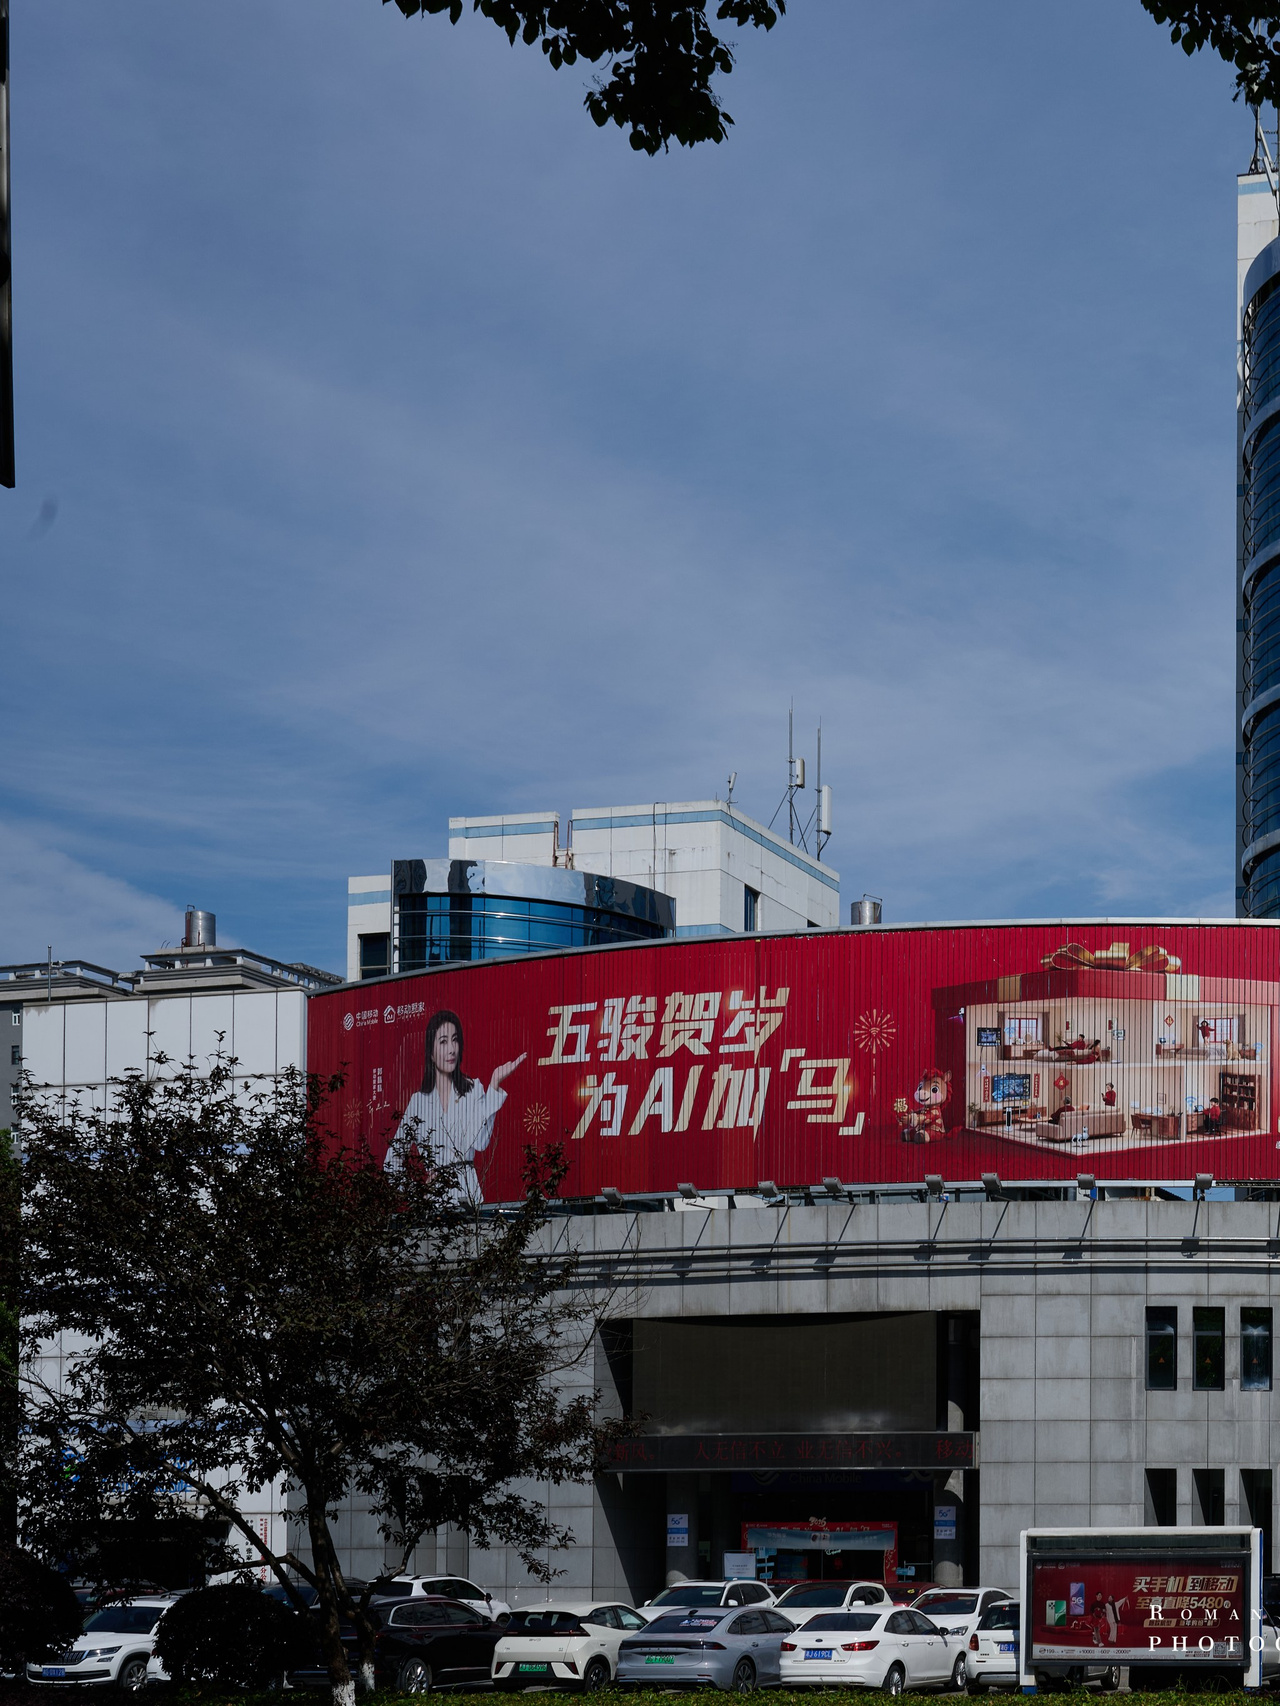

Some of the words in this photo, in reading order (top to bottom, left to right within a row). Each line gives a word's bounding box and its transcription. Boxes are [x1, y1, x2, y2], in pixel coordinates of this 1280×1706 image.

[538, 986, 790, 1066] 五骏贺岁
[694, 1440, 785, 1461] 人无信不立
[935, 1439, 971, 1461] 移动
[823, 1471, 863, 1484] Mobile
[1133, 1576, 1185, 1592] 买手机
[1188, 1576, 1236, 1592] 到移动
[1071, 1596, 1083, 1604] 5G
